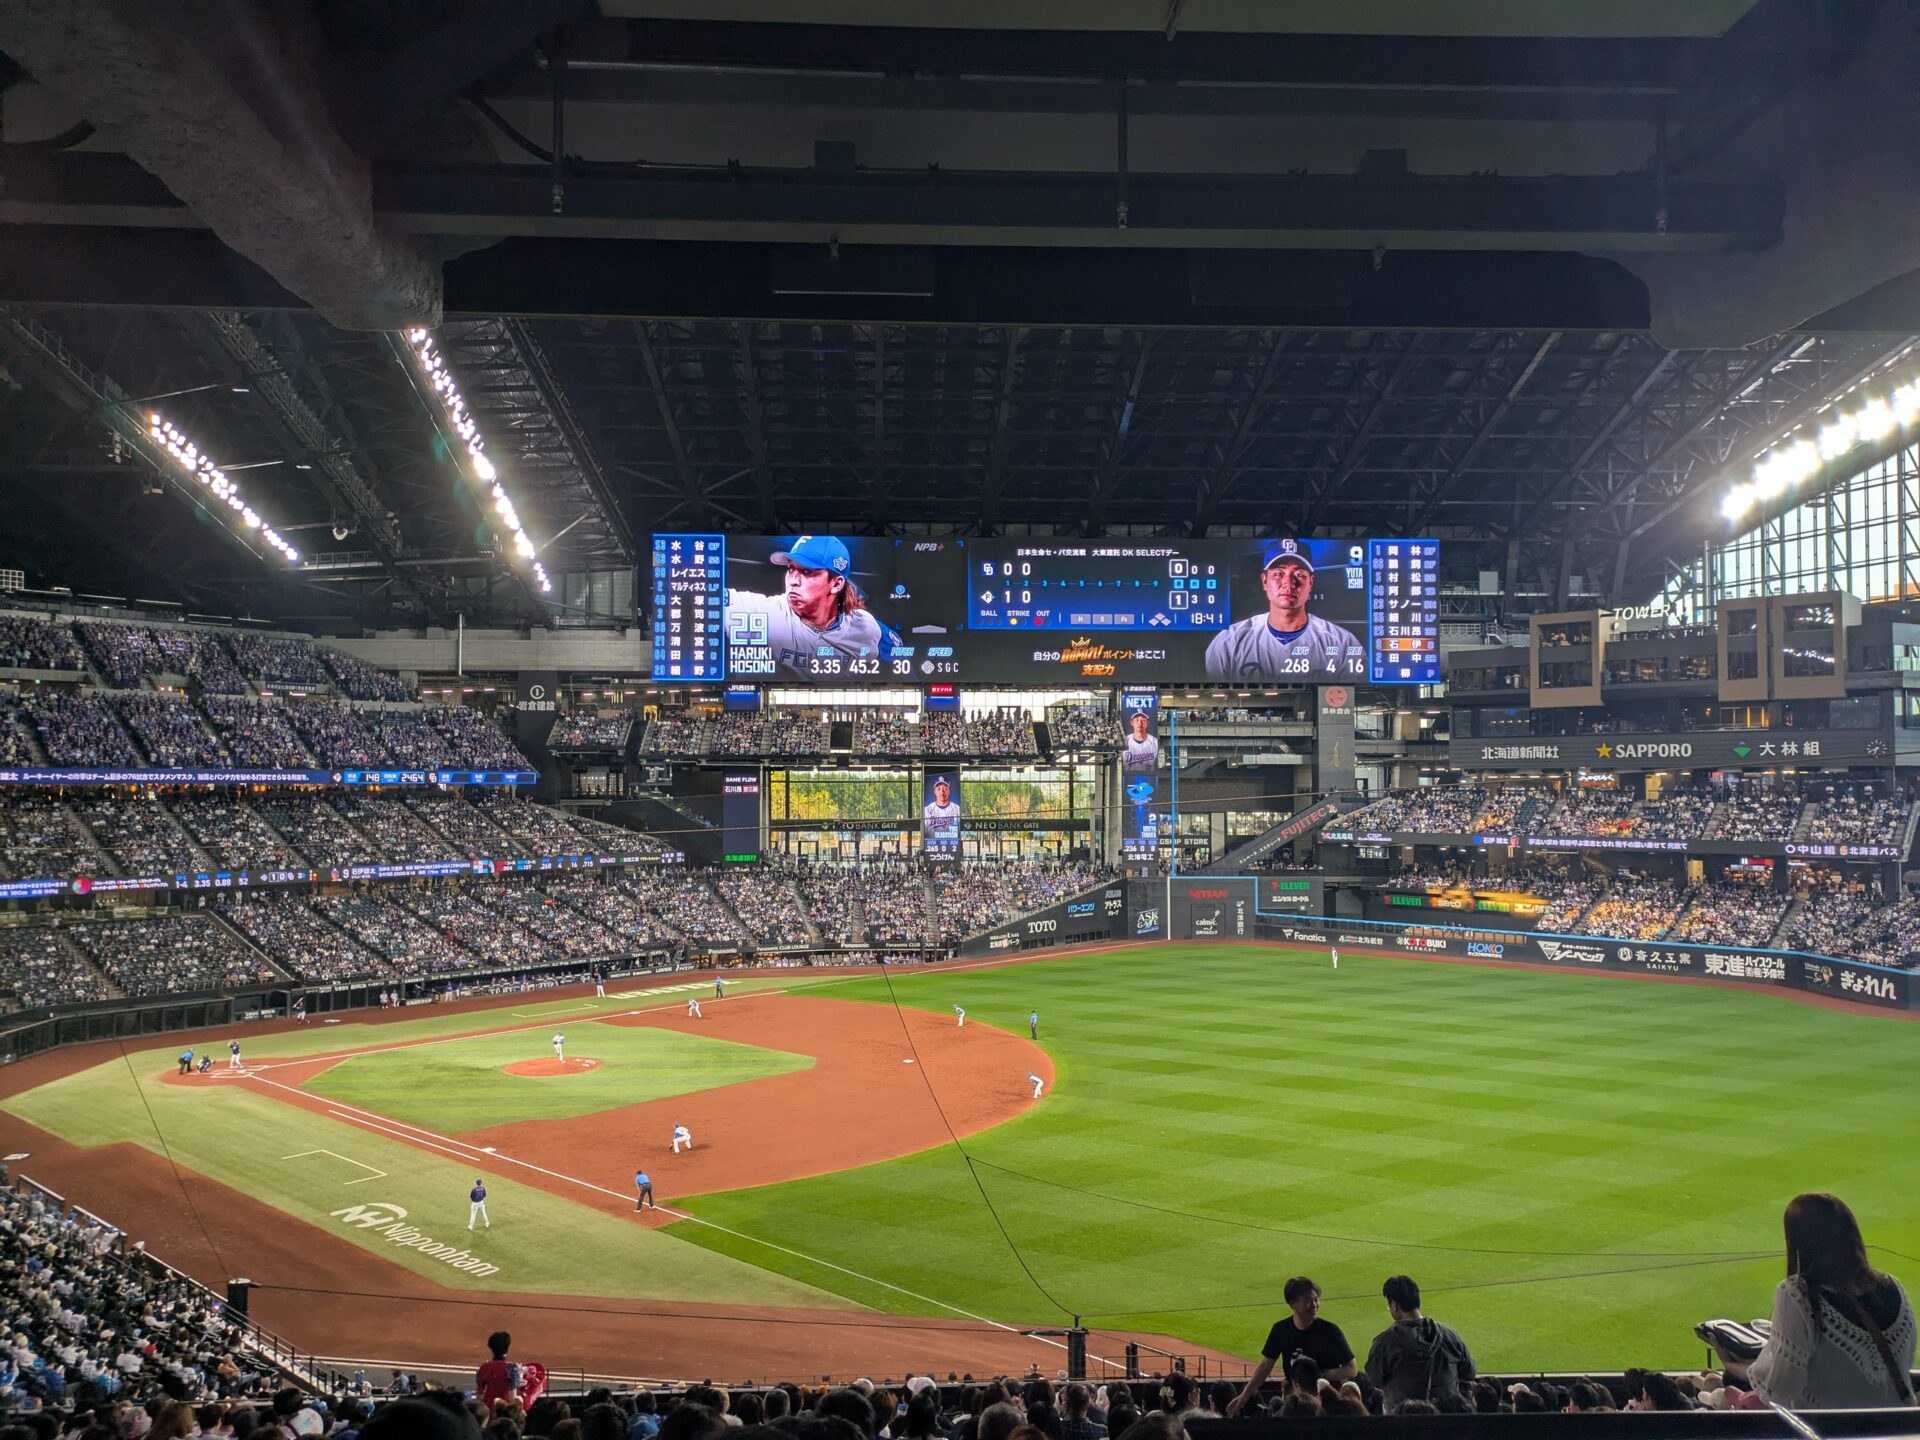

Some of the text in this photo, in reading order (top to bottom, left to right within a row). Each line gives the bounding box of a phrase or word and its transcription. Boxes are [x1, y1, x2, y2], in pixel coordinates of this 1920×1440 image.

[914, 543, 945, 551] NPB+
[1376, 545, 1381, 556] 1
[1350, 546, 1363, 566] 9
[671, 568, 706, 578] レイエス
[1003, 563, 1215, 575] 0 0 0 0 0
[1346, 568, 1363, 578] YUTA
[1005, 591, 1215, 605] 1 0 1 3 0
[1613, 605, 1670, 620] TOWER
[1191, 613, 1223, 624] 18:41
[730, 612, 768, 645] 29
[730, 647, 772, 660] HARUKI
[817, 647, 953, 656] ERA IP PITCH SPEED
[1292, 647, 1362, 655] AVG HR RBI
[1389, 653, 1421, 663] 田中
[730, 660, 775, 673] HOSONO
[811, 659, 841, 673] 3.35
[849, 659, 880, 674] 45.2
[892, 659, 911, 674] 30
[1082, 665, 1115, 675] 支配力
[1281, 659, 1364, 673] .268 4 16
[518, 701, 555, 711] 岩倉建設
[1126, 698, 1154, 708] NEXT
[1481, 746, 1559, 759] 北海道新聞社
[1616, 744, 1692, 757] SAPPORO
[1759, 741, 1820, 756] 大林組
[401, 773, 424, 781] 2464
[1281, 808, 1327, 839] FUJITEC
[1797, 845, 1835, 855] 中山組
[1850, 846, 1899, 856] 北海道バス
[1138, 911, 1159, 922] ASK
[1028, 920, 1056, 933] TOTO
[1294, 932, 1326, 942] Fanatics
[1404, 937, 1446, 948] KOTOBUKI
[1468, 942, 1504, 953] HOKKO
[1552, 949, 1605, 962] ジーベック
[1646, 963, 1679, 971] SAIKYU
[1705, 954, 1745, 976] 東進
[1745, 956, 1785, 969] ハイスクール
[1841, 970, 1897, 1000] ぎょれん
[375, 1222, 500, 1277] Nipponham
